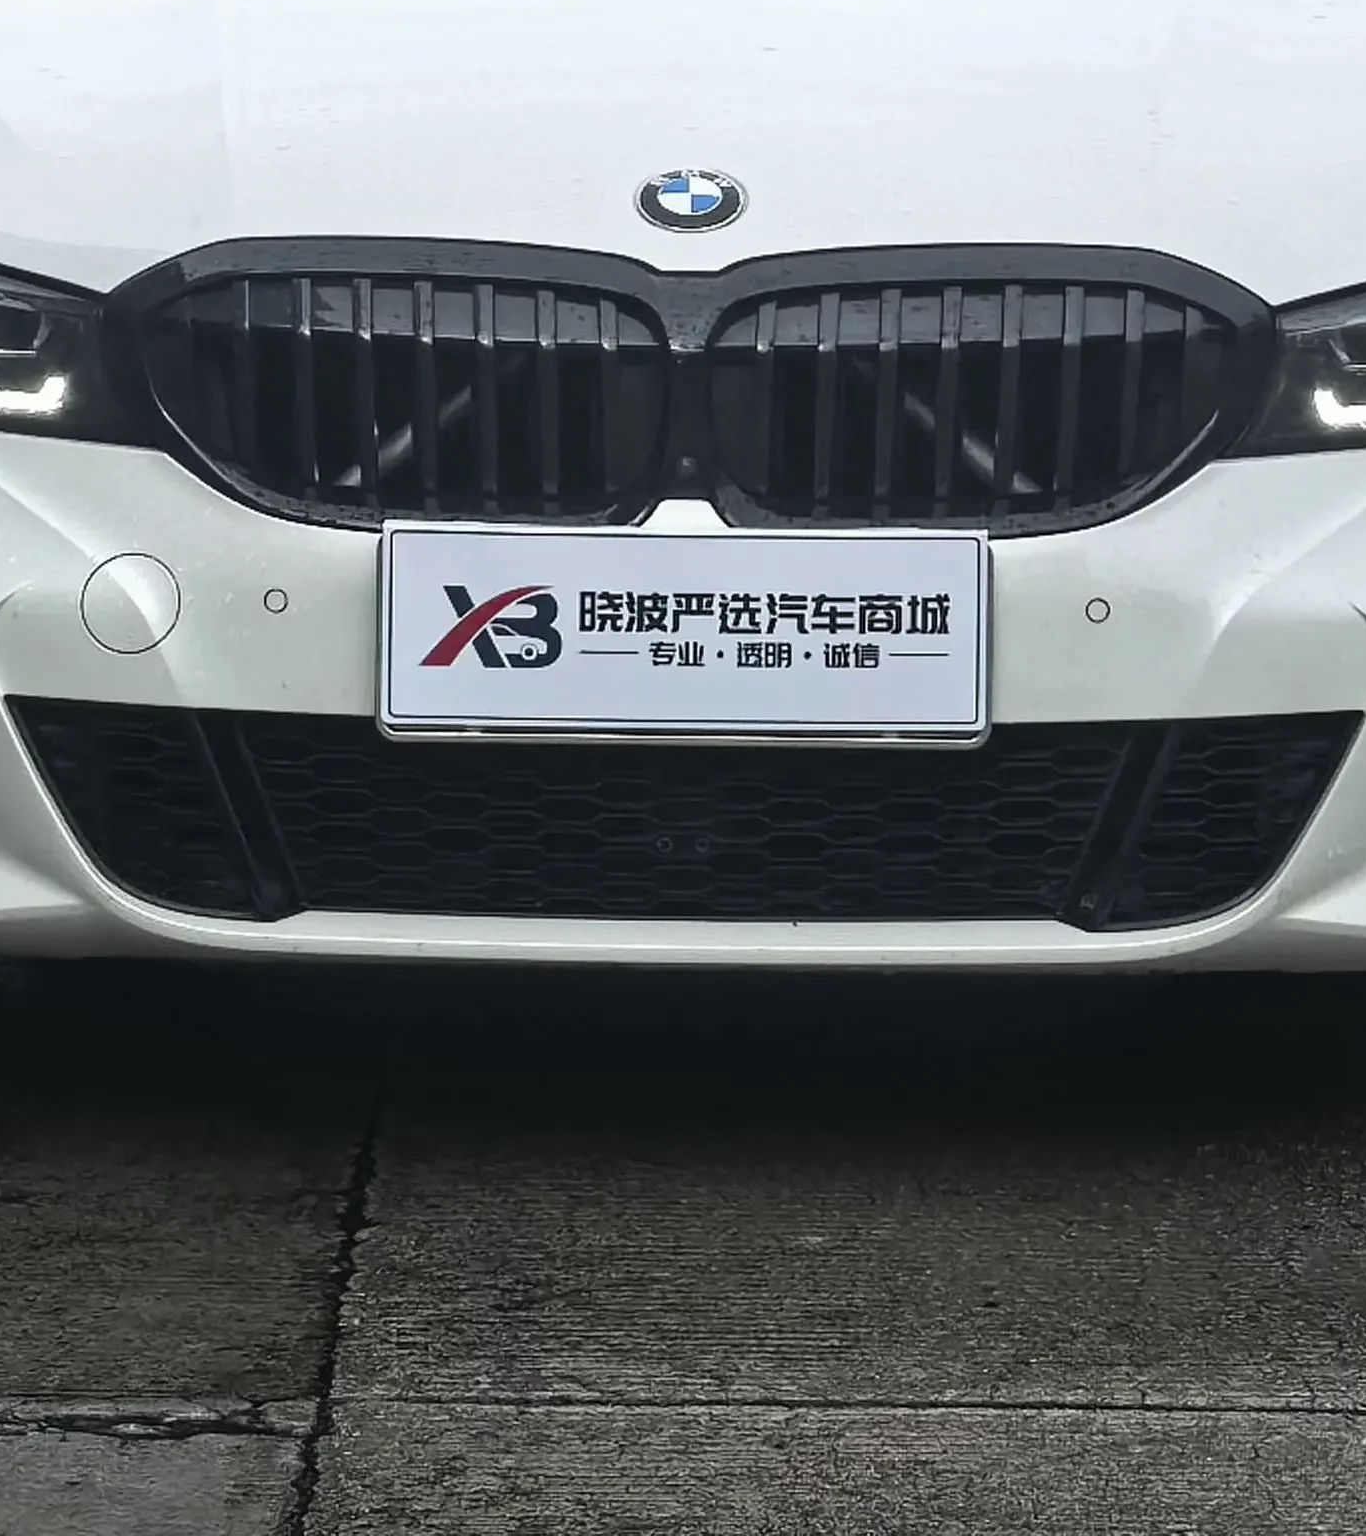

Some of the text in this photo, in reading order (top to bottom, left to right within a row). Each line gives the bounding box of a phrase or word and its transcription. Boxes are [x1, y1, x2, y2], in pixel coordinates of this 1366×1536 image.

[578, 590, 951, 635] 晓波严选汽车商城
